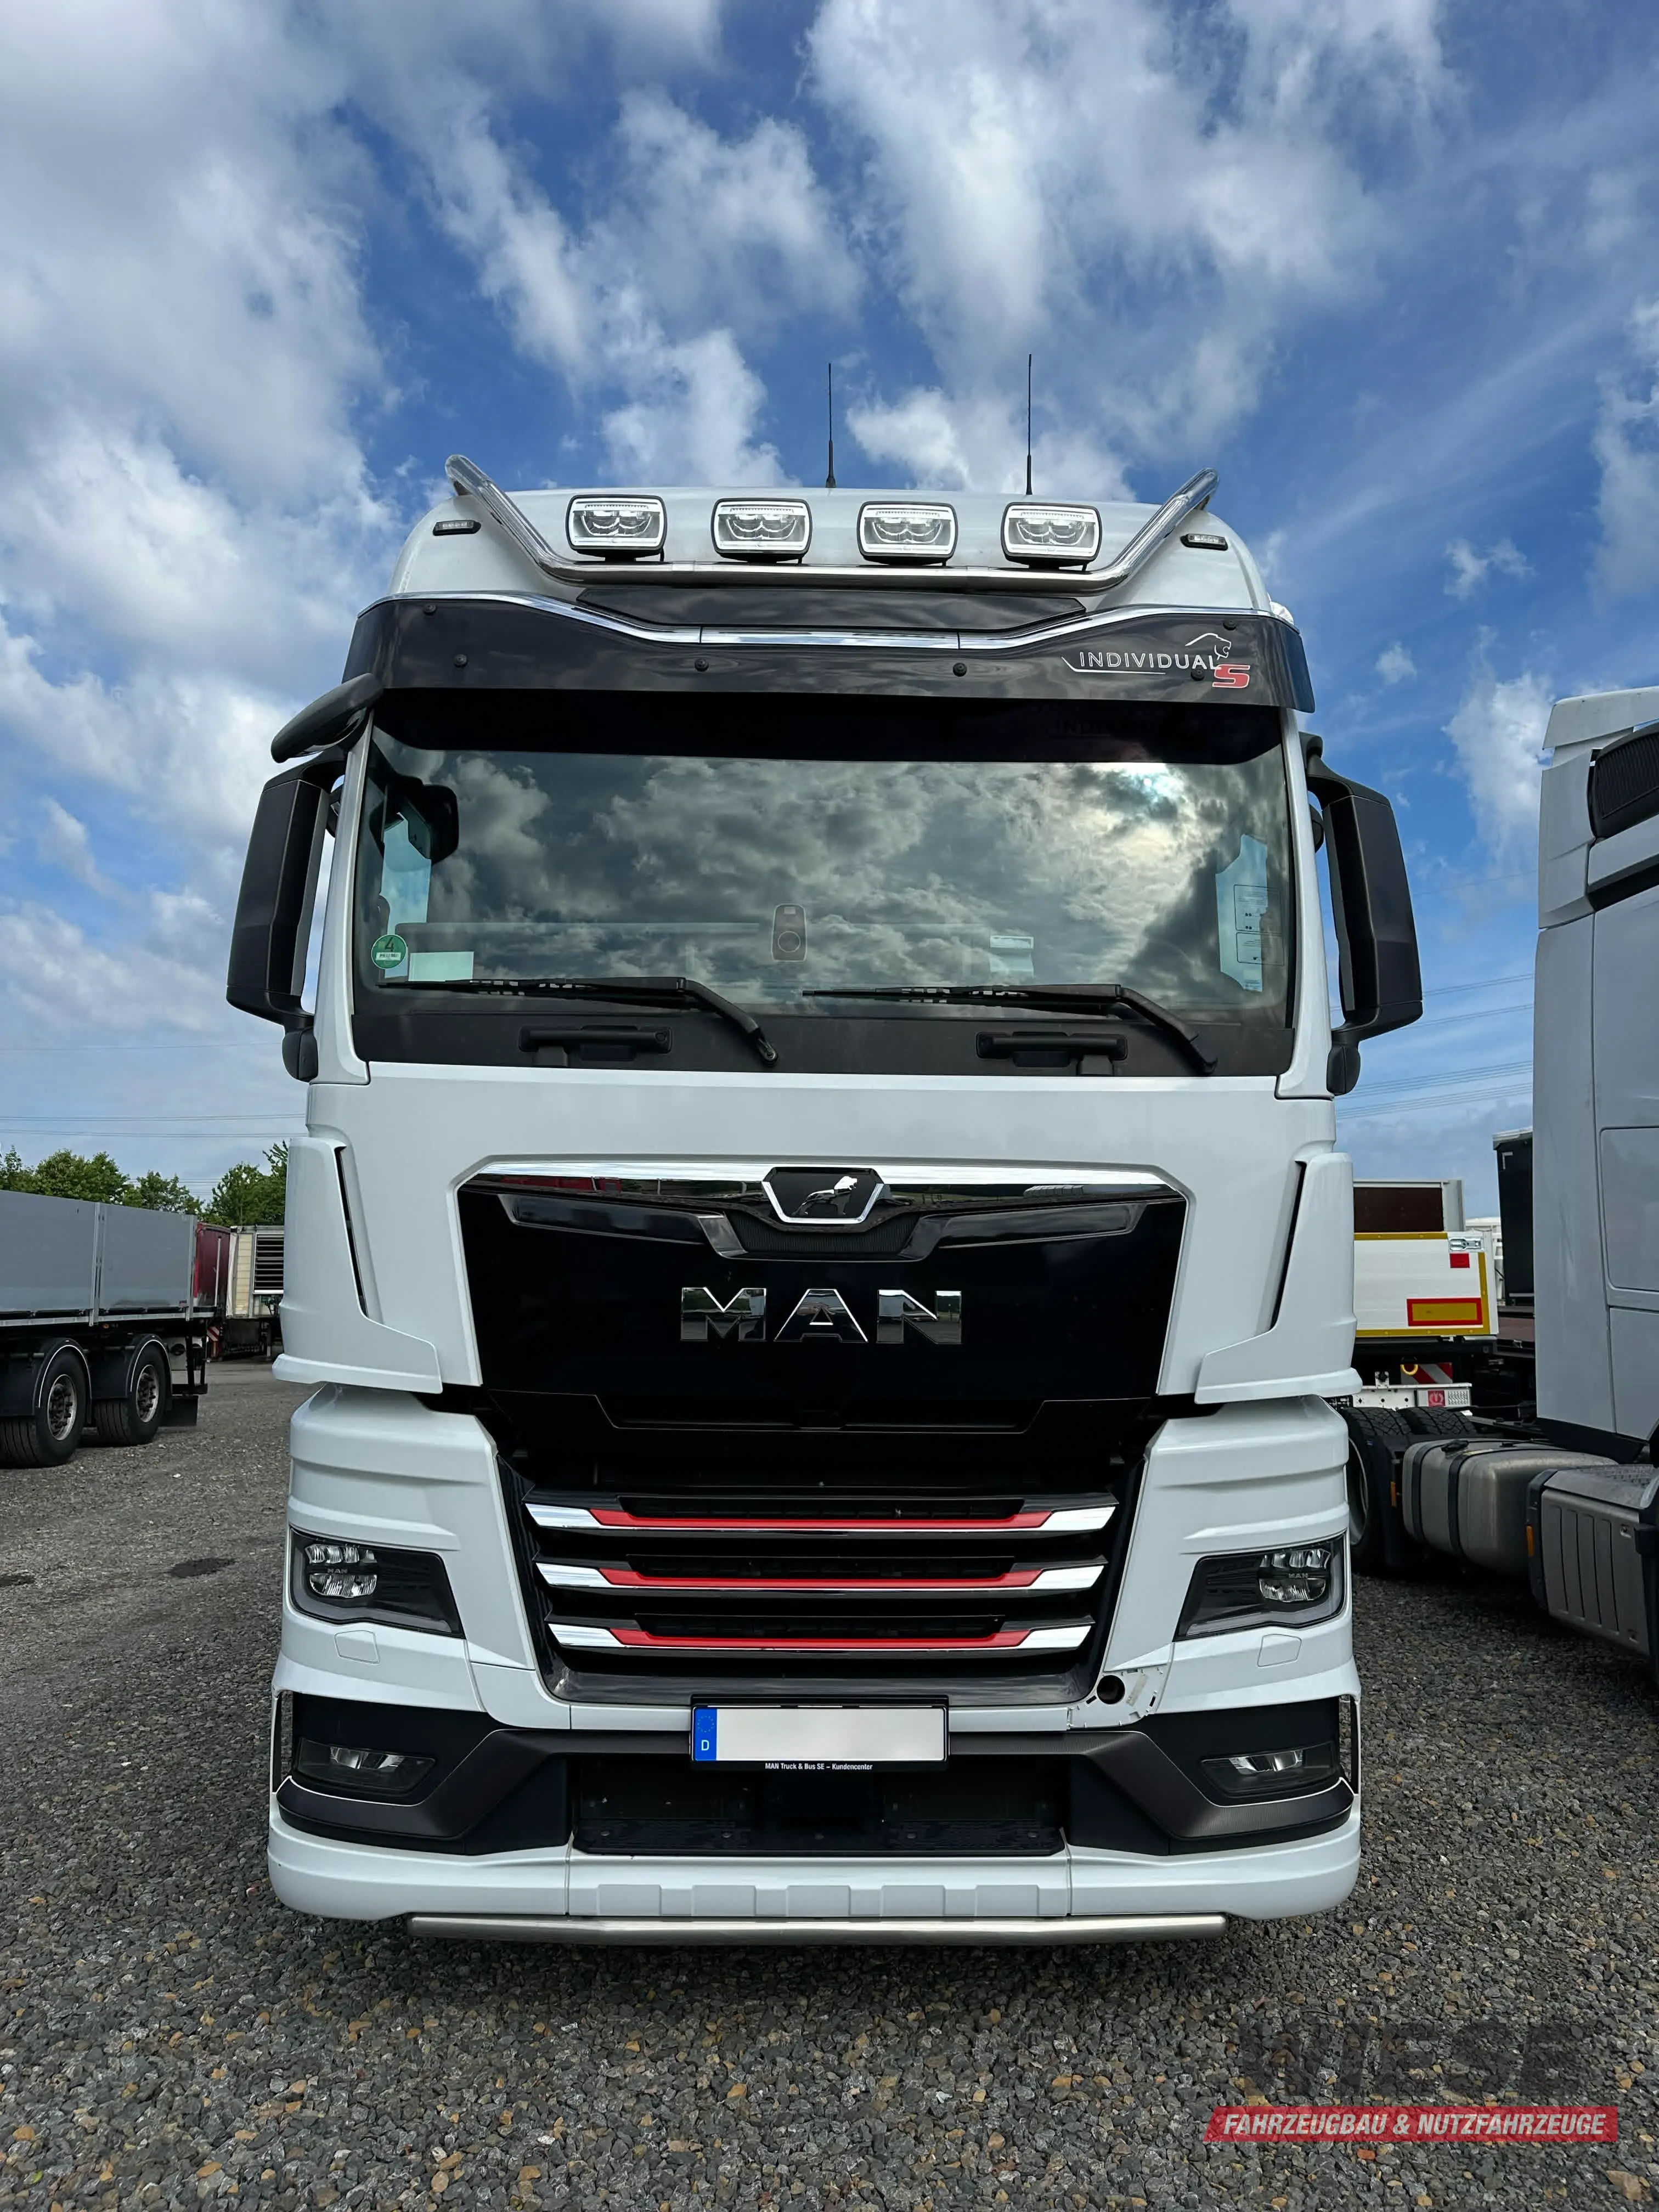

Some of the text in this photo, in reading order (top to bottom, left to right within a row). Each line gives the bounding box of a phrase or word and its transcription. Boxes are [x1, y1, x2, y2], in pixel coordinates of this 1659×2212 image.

[1080, 651, 1221, 670] INDIVIDUAL
[1211, 663, 1251, 689] S
[384, 936, 394, 952] 4
[680, 1286, 962, 1345] MAN
[701, 1740, 710, 1751] D
